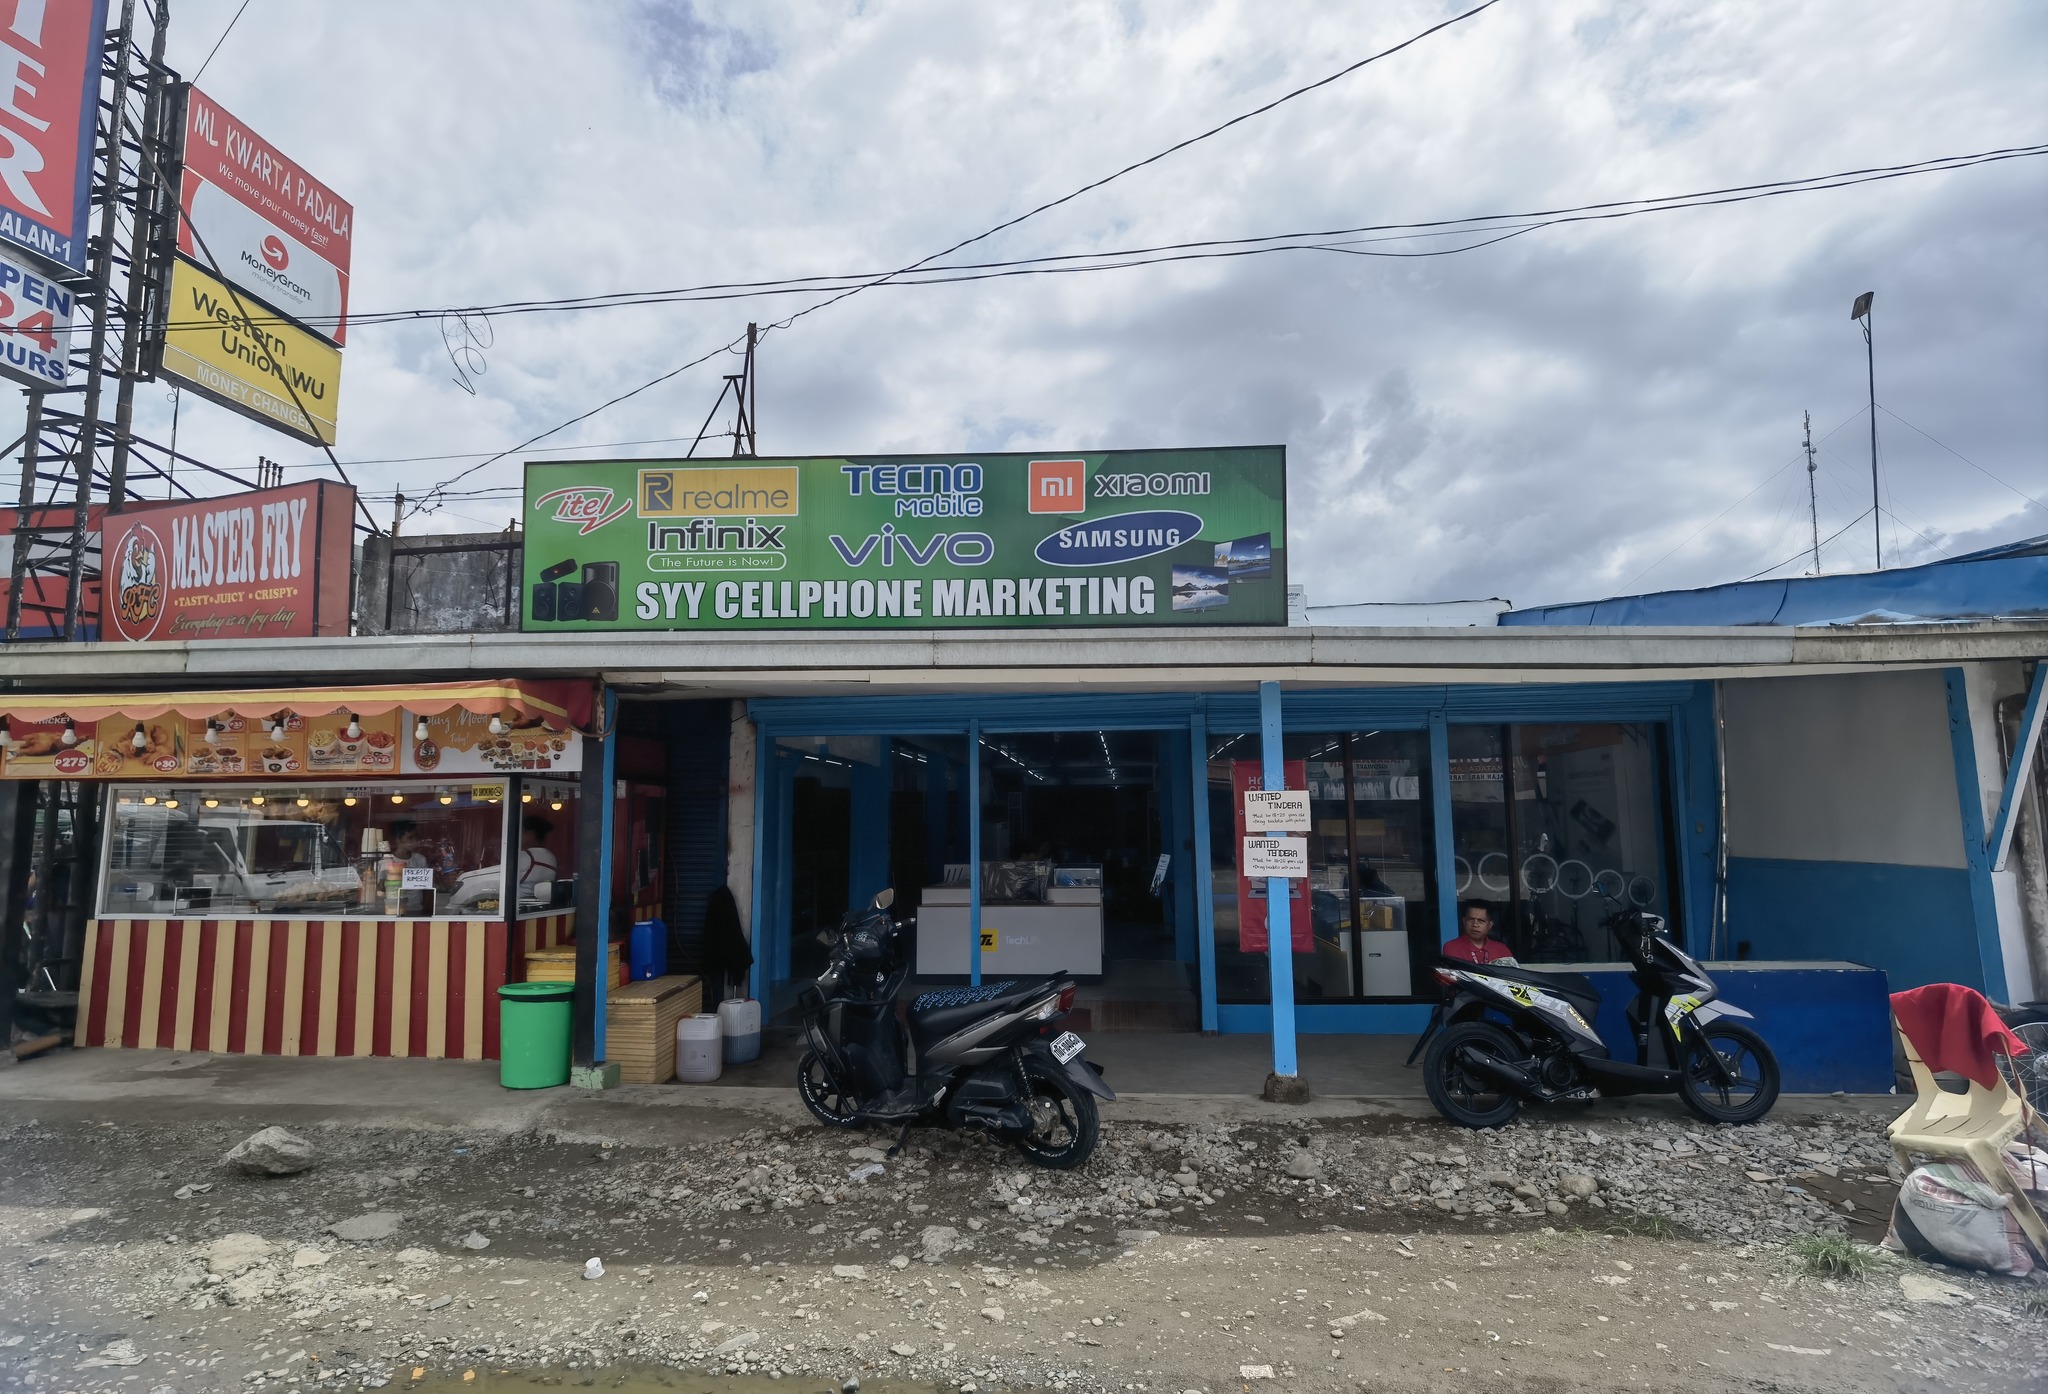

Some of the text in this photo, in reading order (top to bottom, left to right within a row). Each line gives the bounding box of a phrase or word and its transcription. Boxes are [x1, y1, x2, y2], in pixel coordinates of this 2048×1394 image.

[194, 103, 349, 241] ML KWARTA PADALA
[219, 162, 329, 246] We move your money fast!
[241, 250, 312, 301] MoneyGram
[192, 287, 286, 357] Western
[0, 339, 65, 381] URS
[221, 330, 284, 380] Union
[197, 365, 249, 400] MONEY
[840, 463, 983, 495] TECNO
[557, 490, 614, 518] itel
[683, 484, 789, 510] realme
[895, 493, 983, 518] Mobile
[171, 497, 307, 590] MASTER FRY
[648, 518, 787, 551] Infinix
[829, 522, 995, 567] vivo
[1059, 528, 1180, 549] SAMSUNG
[660, 556, 774, 568] The Future is Now!
[178, 587, 294, 607] TASTY JUICY CRISPY
[635, 575, 1156, 621] SYY CELLPHONE MARKETING
[169, 612, 228, 636] Everyday
[244, 608, 267, 634] fry
[269, 606, 296, 630] day
[55, 756, 87, 768] P275
[1248, 792, 1282, 802] WANTED
[1268, 801, 1303, 810] TINDERA
[1248, 840, 1280, 849] WANTED
